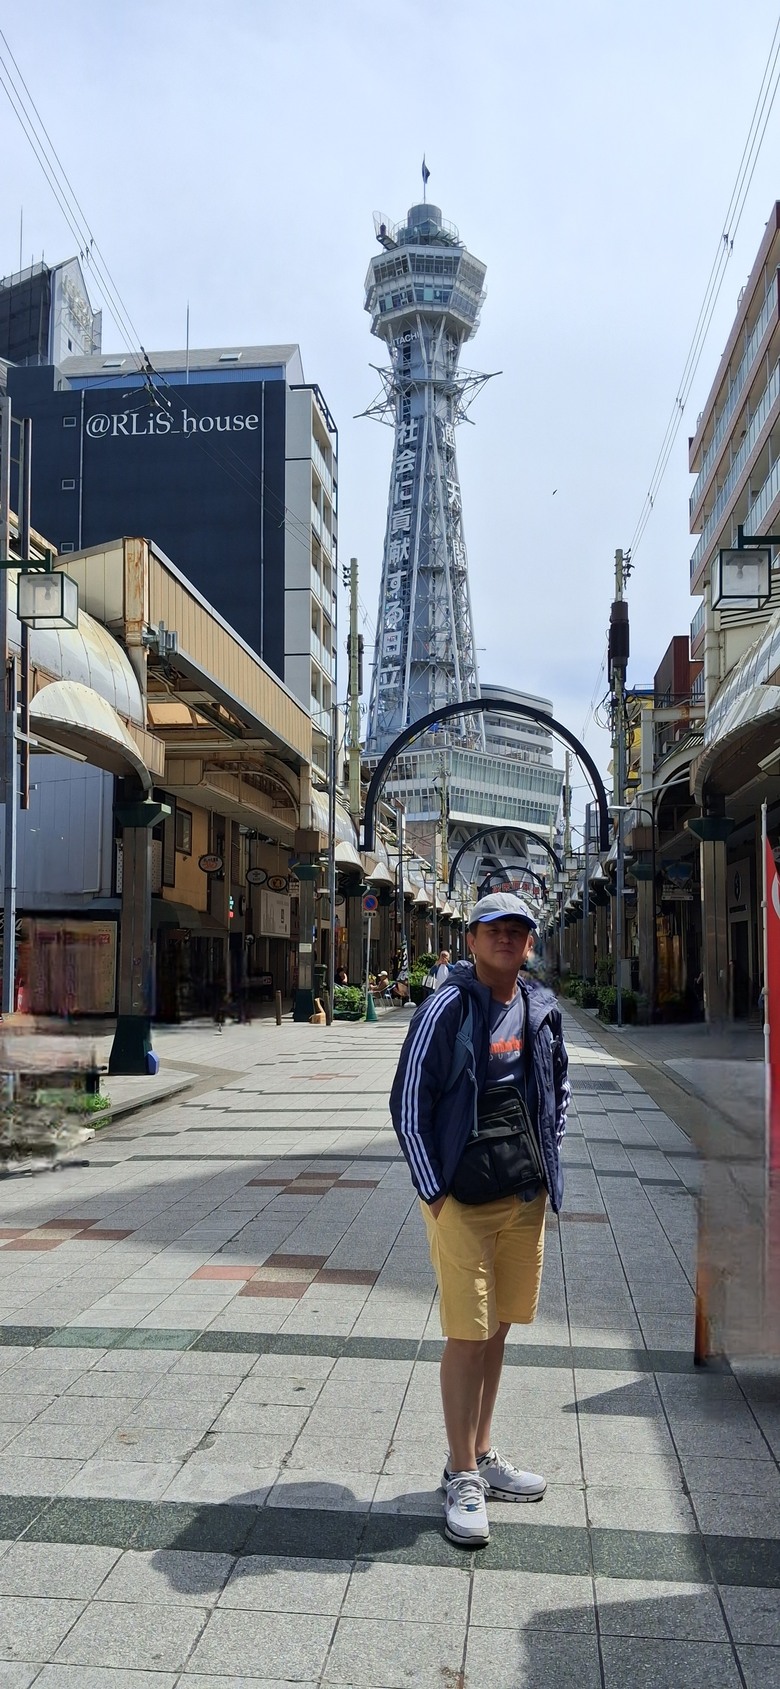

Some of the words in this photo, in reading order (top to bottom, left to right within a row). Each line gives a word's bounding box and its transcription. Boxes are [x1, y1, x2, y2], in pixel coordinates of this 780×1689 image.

[86, 409, 259, 438] @RLiS_house
[379, 418, 418, 690] 社会に貢献する日立
